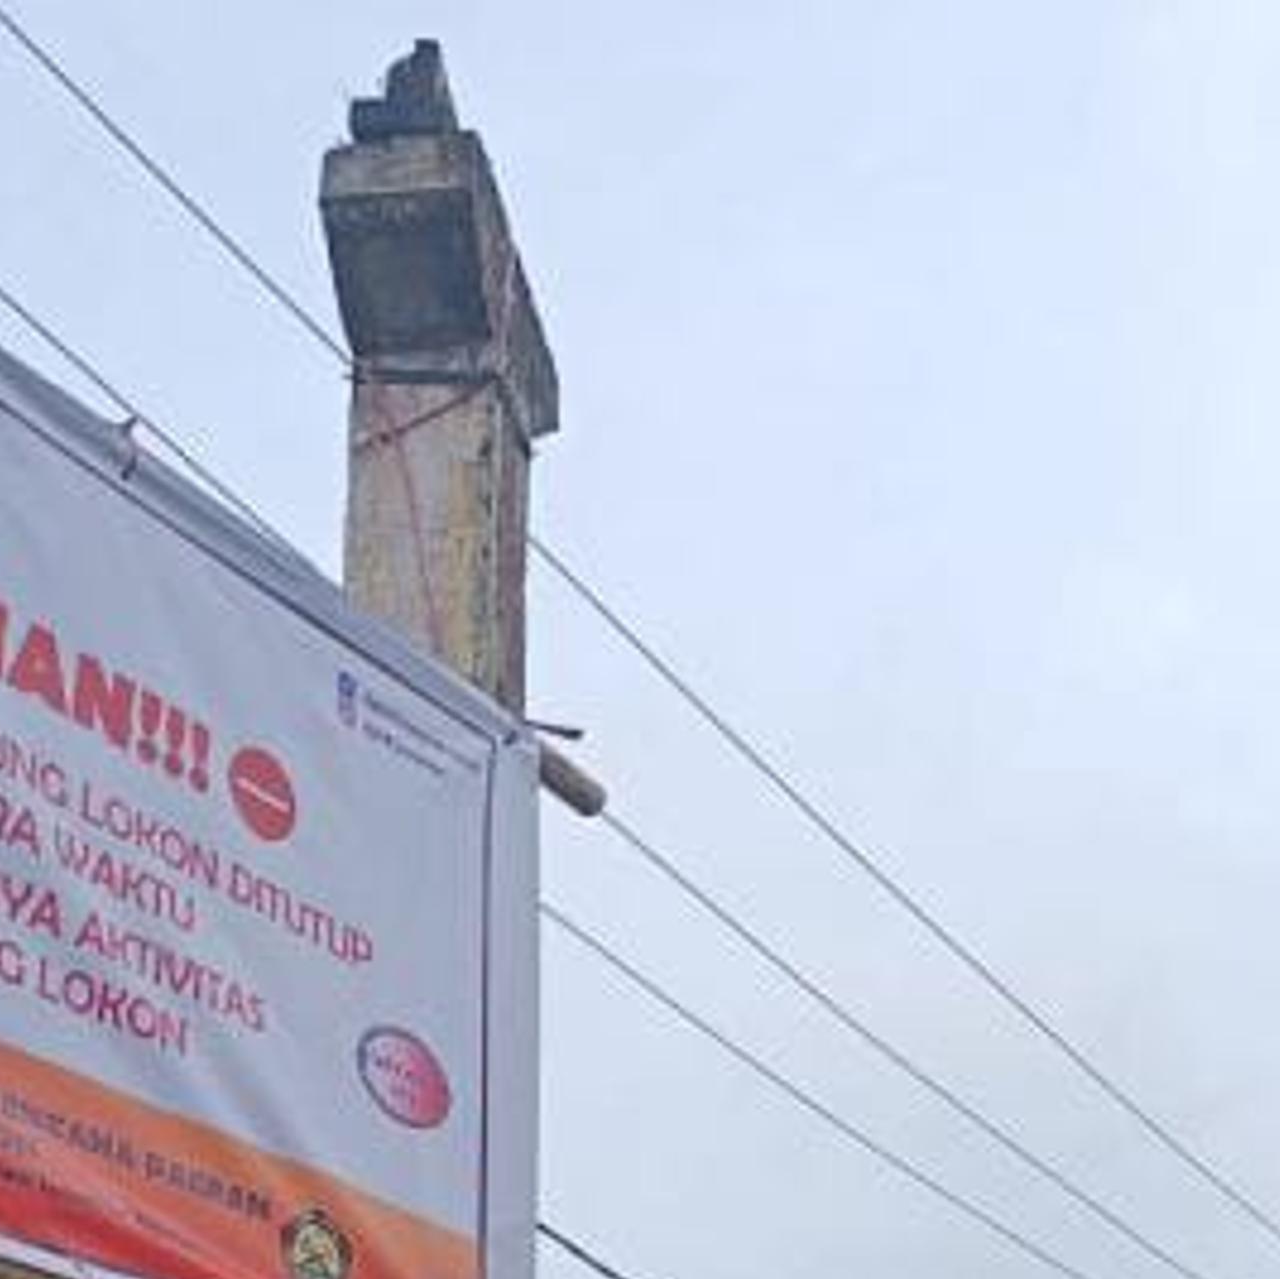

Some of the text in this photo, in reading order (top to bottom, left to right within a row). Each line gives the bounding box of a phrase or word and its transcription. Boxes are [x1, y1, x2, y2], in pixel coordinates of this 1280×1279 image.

[53, 822, 196, 932] WAKTU
[80, 781, 219, 890] LOKON
[228, 862, 373, 964] DITUTUP
[36, 960, 188, 1057] LOKON
[73, 913, 266, 1032] AKTIVITAS
